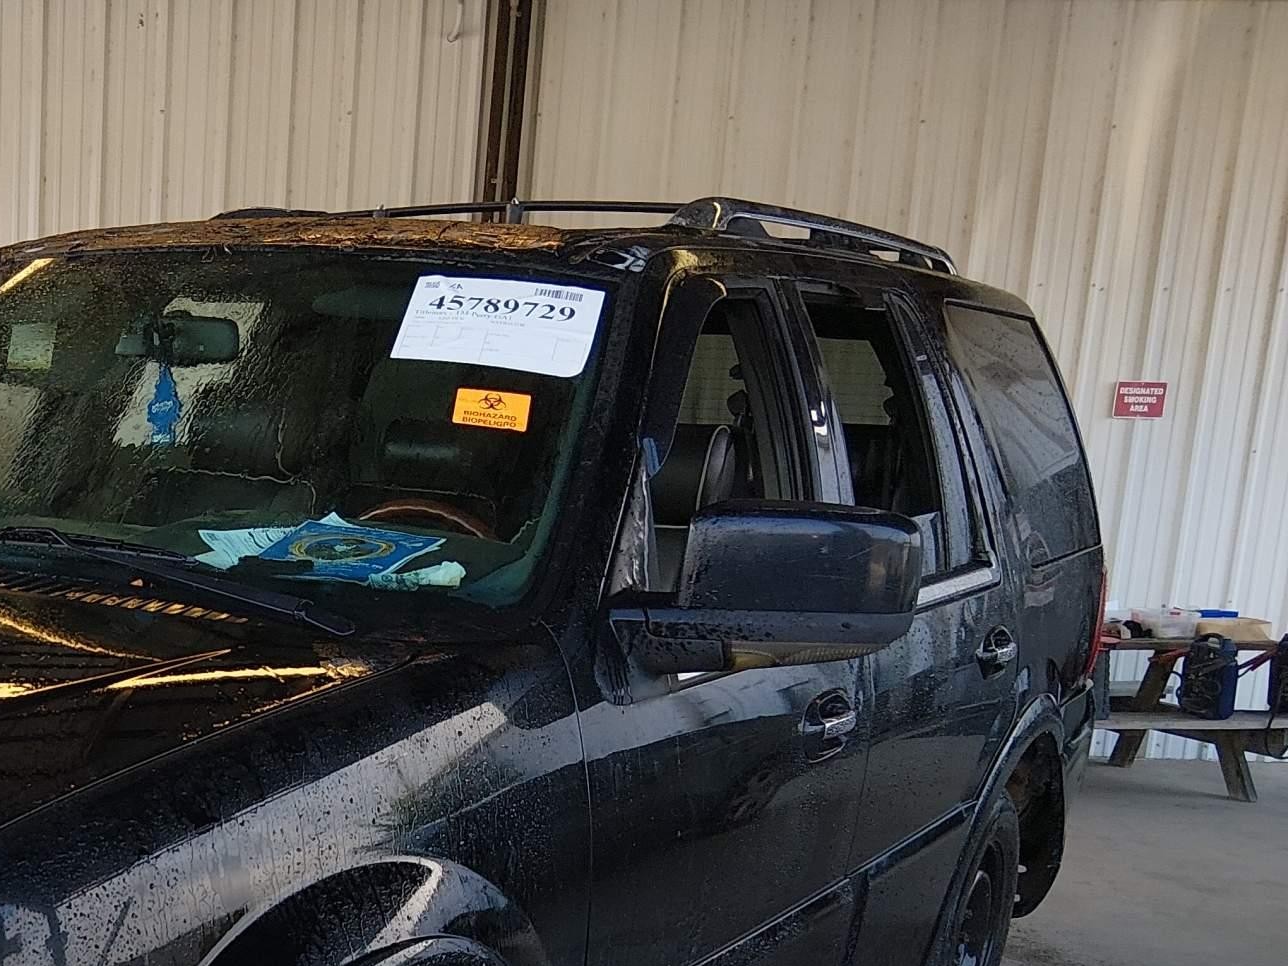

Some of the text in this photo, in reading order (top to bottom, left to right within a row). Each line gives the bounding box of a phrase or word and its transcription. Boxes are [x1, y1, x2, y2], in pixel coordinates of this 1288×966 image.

[429, 295, 576, 322] 45789729
[1119, 387, 1164, 395] DESIGNATED
[1124, 395, 1157, 404] SMOKING
[1129, 404, 1149, 412] AREA
[463, 410, 517, 422] BIOHAZARD
[462, 417, 517, 428] BIOPELIGRO
